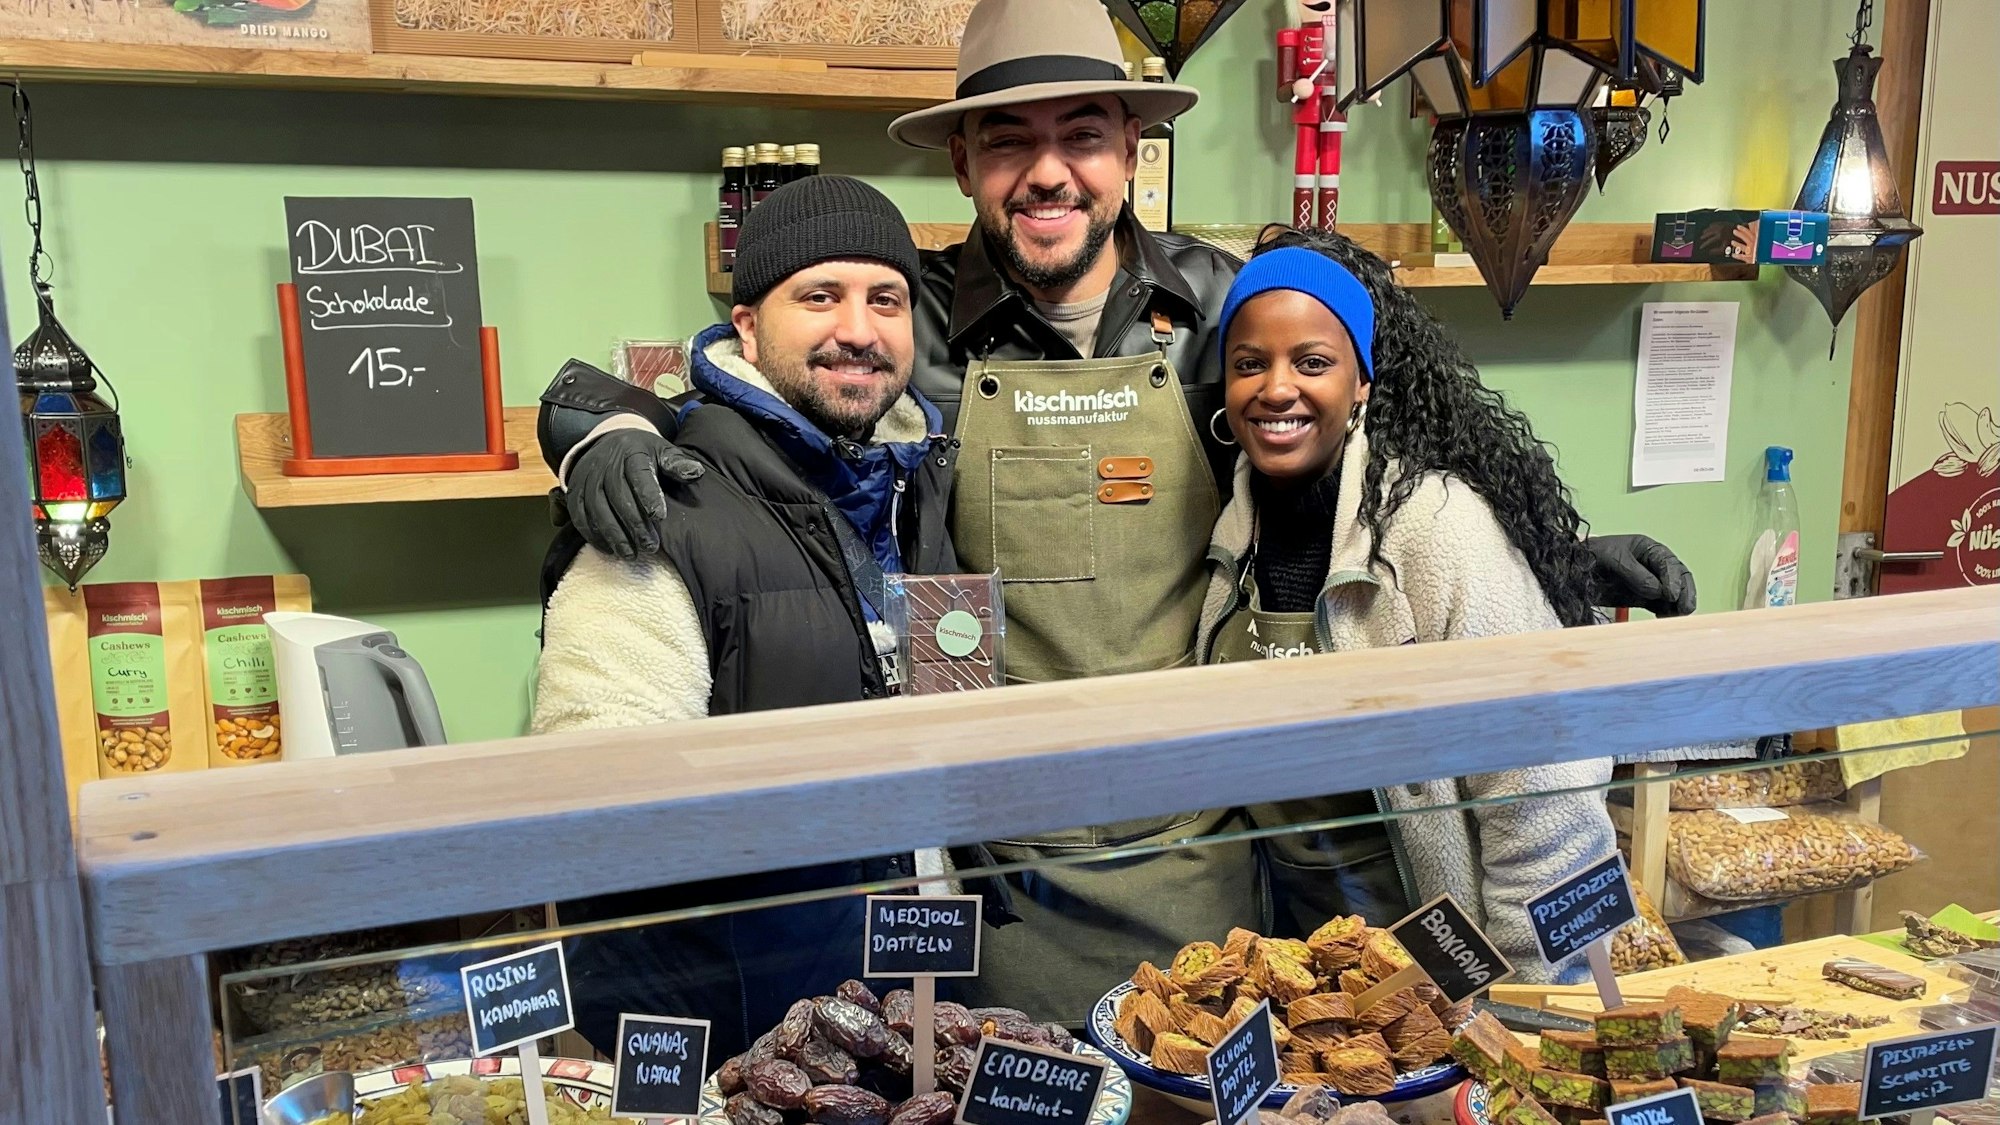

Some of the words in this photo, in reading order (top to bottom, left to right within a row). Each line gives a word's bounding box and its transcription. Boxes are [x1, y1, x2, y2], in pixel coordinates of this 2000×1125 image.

[240, 23, 277, 36] DRIED
[282, 26, 329, 39] MANGO
[296, 219, 445, 270] DUBAI
[306, 284, 435, 318] Schokolade
[348, 347, 427, 389] 15,-
[1027, 410, 1129, 426] nussmanufaktur
[100, 641, 151, 651] Cashews
[217, 632, 267, 643] Cashews
[107, 666, 148, 678] Curry
[223, 656, 265, 669] Chilli
[1533, 864, 1623, 925] PISTAZIEN
[879, 906, 965, 928] MEDJOOL
[872, 934, 953, 953] DATTELN
[1420, 908, 1492, 986] BAKLAVA
[470, 962, 537, 998] ROSINE
[479, 988, 561, 1029] KANDAHAR
[627, 1030, 689, 1061] ANANAS
[635, 1062, 681, 1086] NATUR
[983, 1051, 1091, 1092] ERDBEERE
[1220, 1053, 1257, 1100] DATTEL
